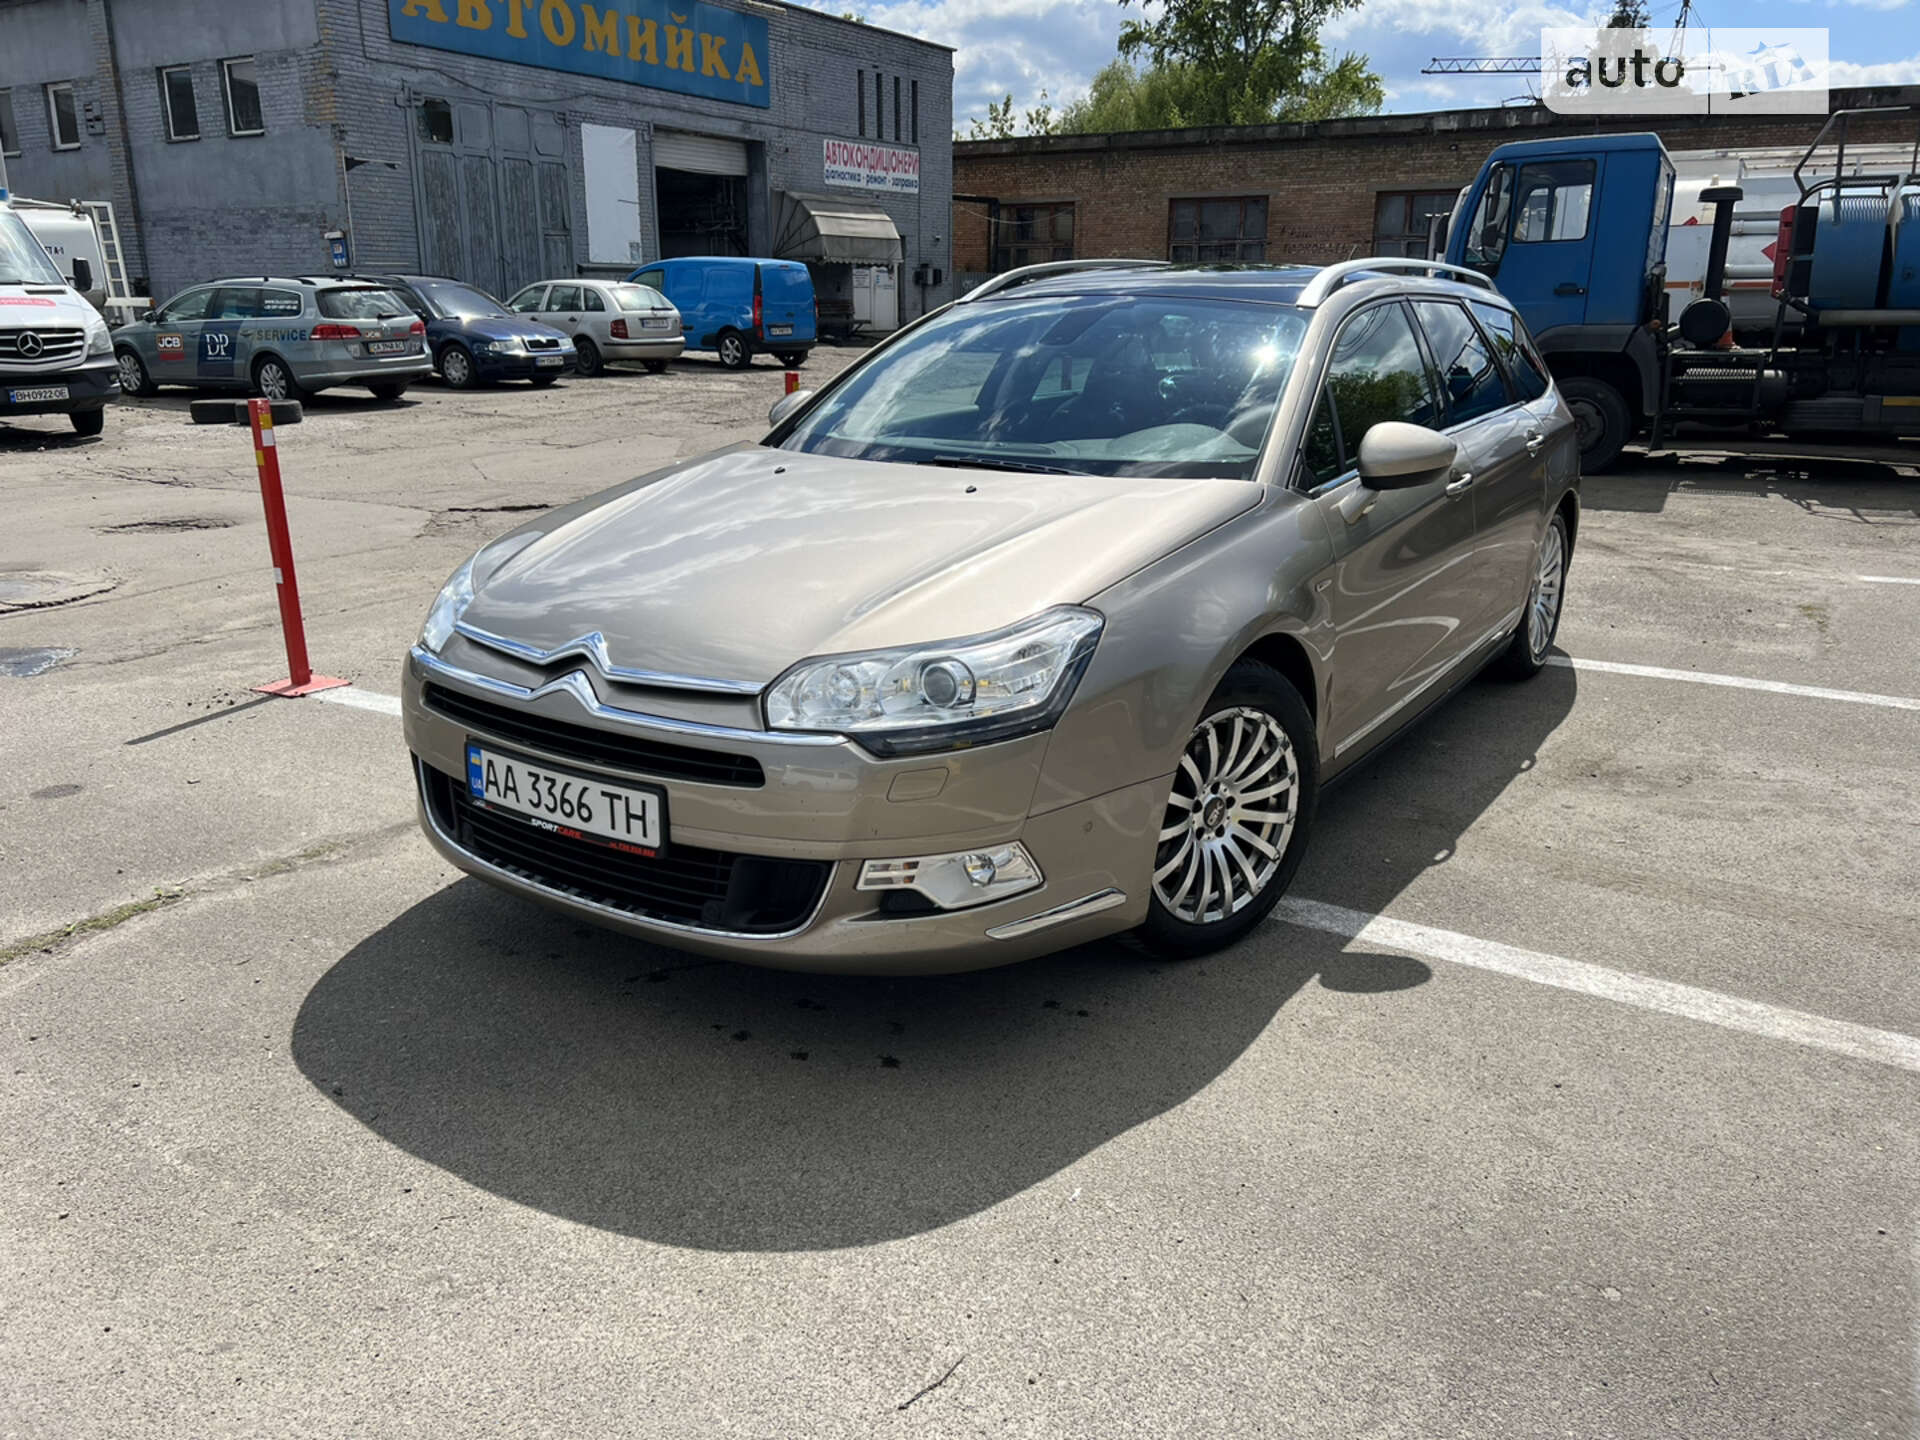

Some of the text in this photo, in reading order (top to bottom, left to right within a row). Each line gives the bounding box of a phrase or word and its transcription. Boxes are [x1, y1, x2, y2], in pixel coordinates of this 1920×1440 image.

[158, 336, 181, 348] JCB
[257, 329, 307, 342] SERVICE
[205, 333, 230, 356] DP
[471, 777, 483, 789] UA
[485, 759, 648, 839] AA 3366 TH
